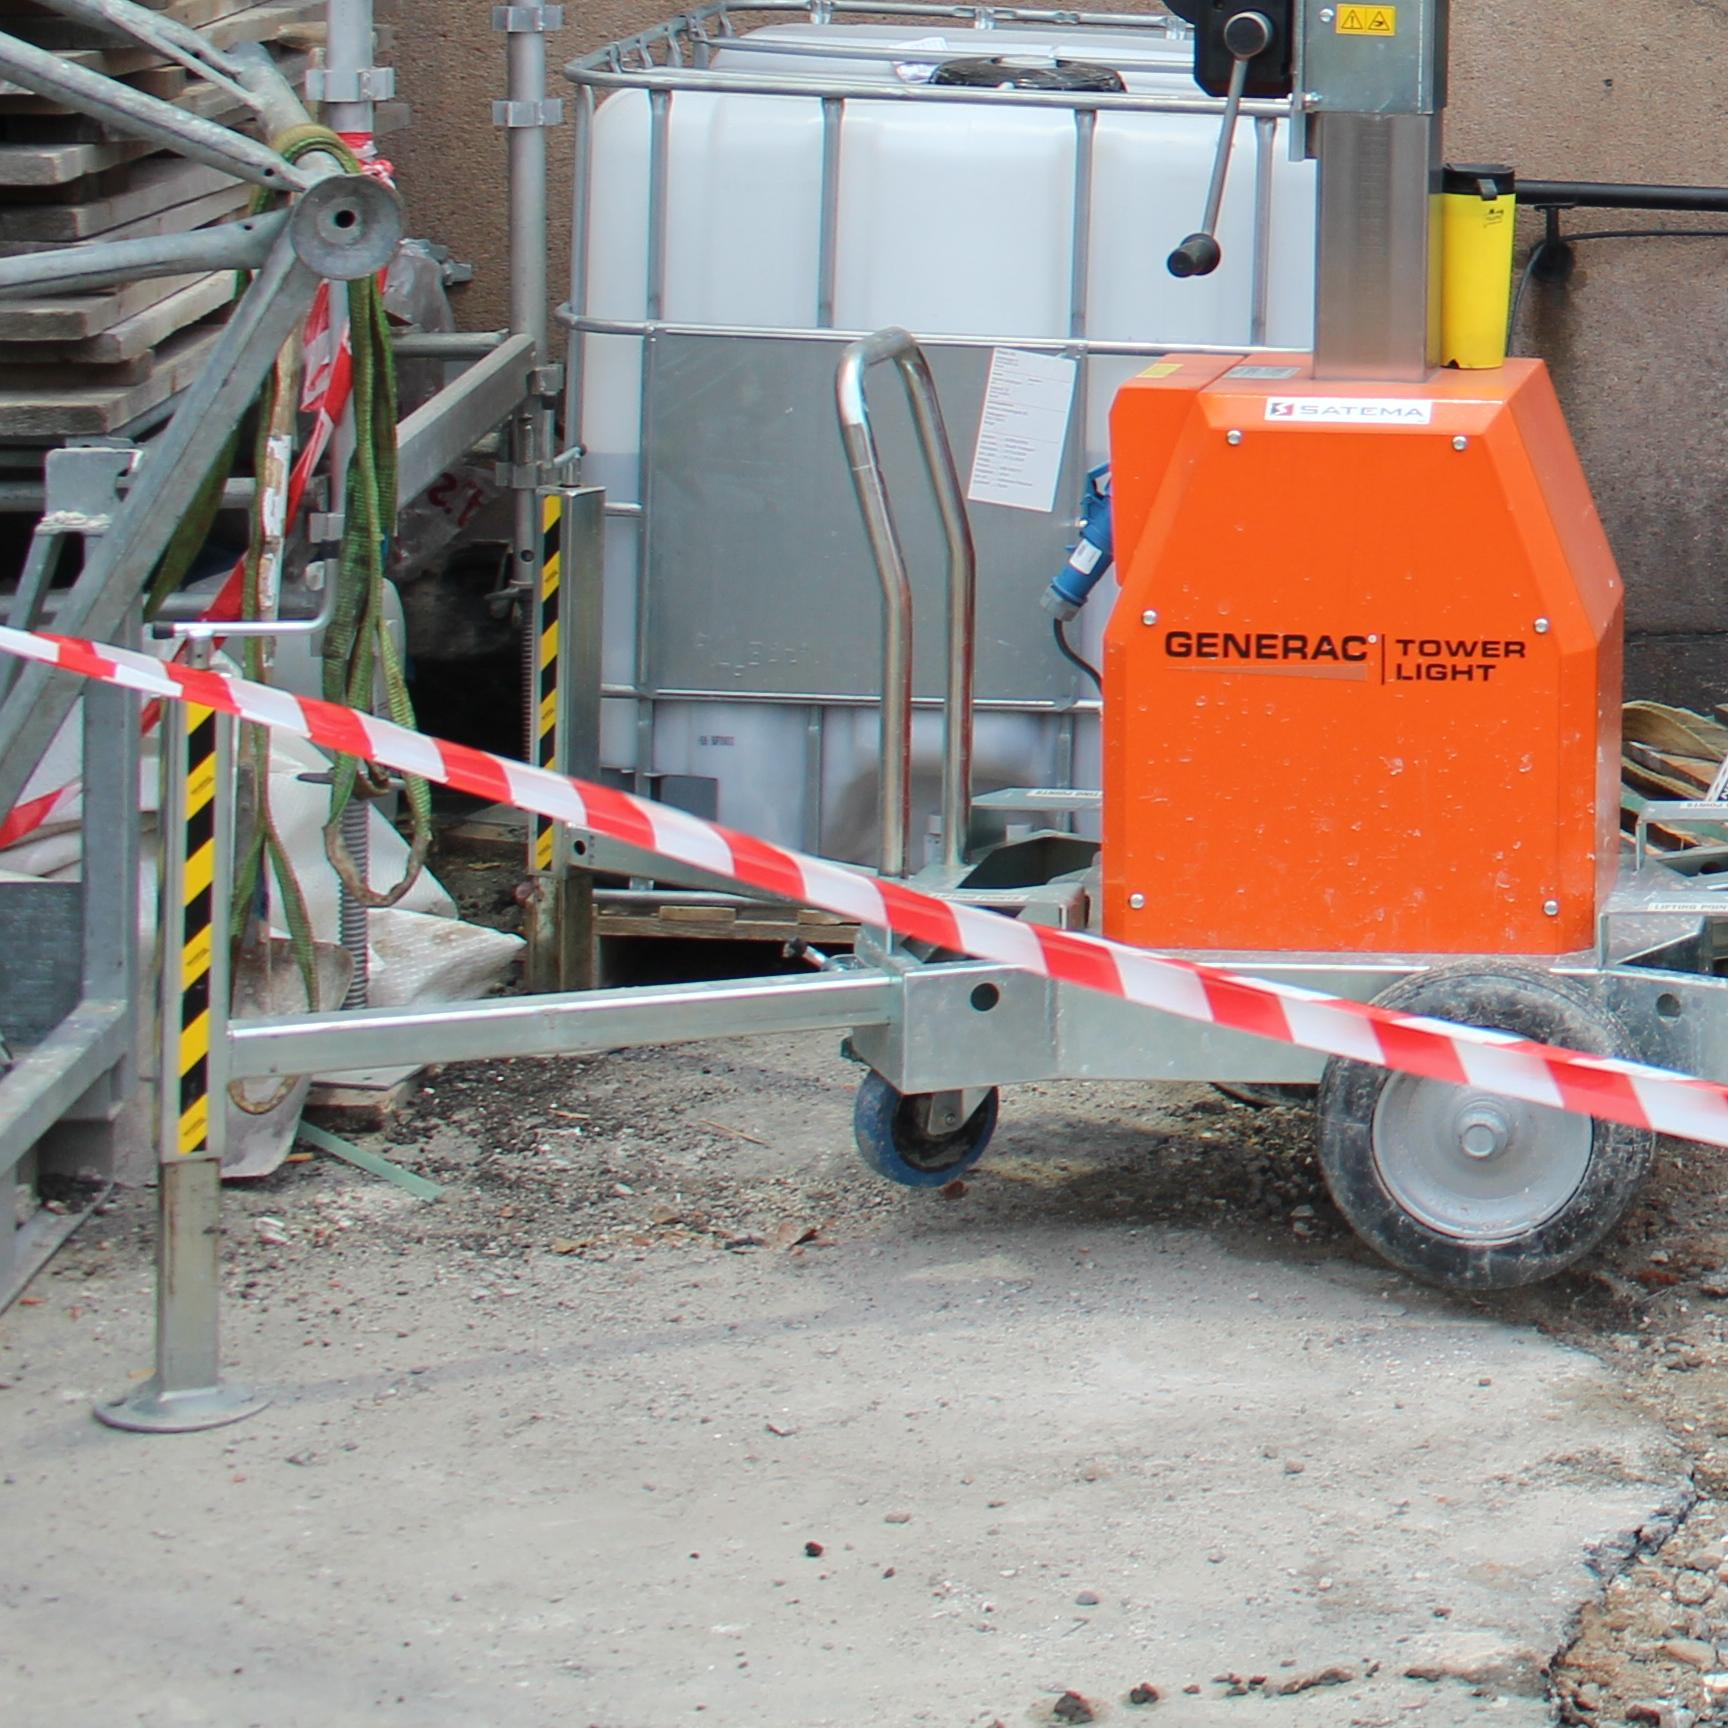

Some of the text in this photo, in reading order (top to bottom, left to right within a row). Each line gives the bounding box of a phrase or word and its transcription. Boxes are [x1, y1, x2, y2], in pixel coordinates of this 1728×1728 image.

[1299, 404, 1424, 419] SATEMA
[1164, 630, 1369, 662] GENERAC
[1395, 639, 1527, 659] TOWER
[1395, 662, 1497, 682] LIGHT
[1654, 903, 1697, 911] LIFTING
